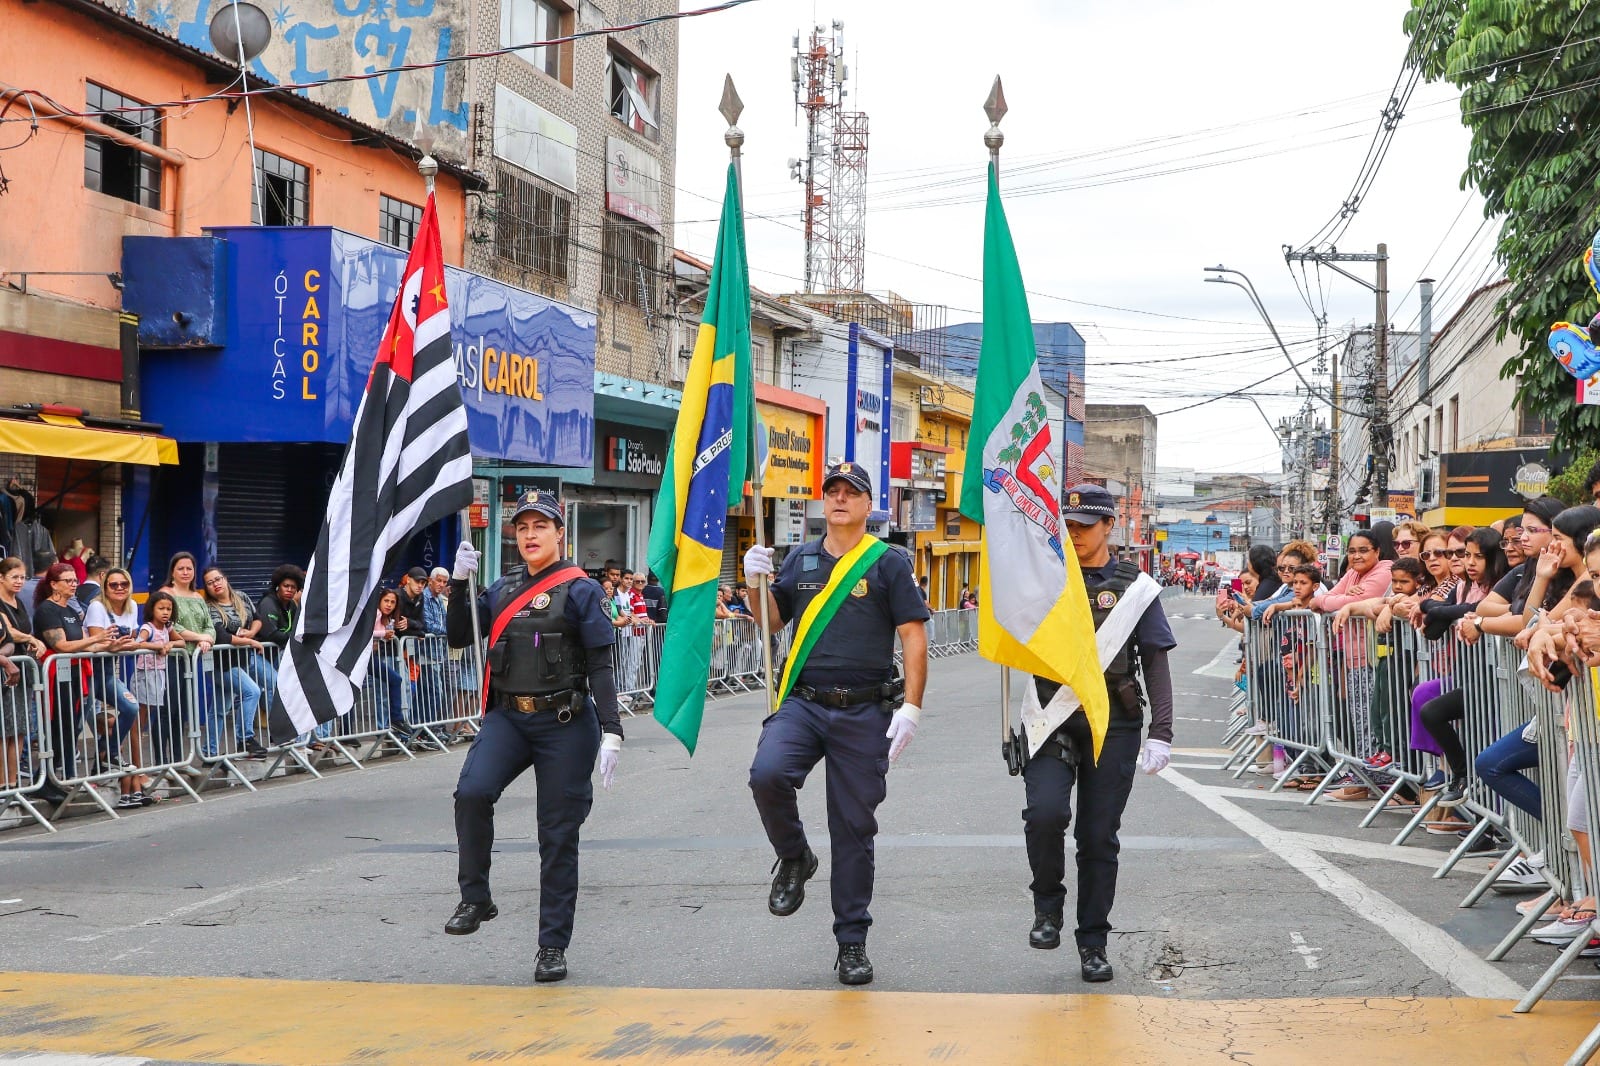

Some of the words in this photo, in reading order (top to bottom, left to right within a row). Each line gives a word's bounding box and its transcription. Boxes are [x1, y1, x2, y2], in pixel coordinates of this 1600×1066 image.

[272, 269, 288, 400] ÓTICAS
[302, 269, 321, 400] CAROL
[453, 343, 478, 389] AS
[483, 347, 544, 401] CAROL
[769, 425, 791, 451] Brasil
[1015, 495, 1042, 521] OMNIA
